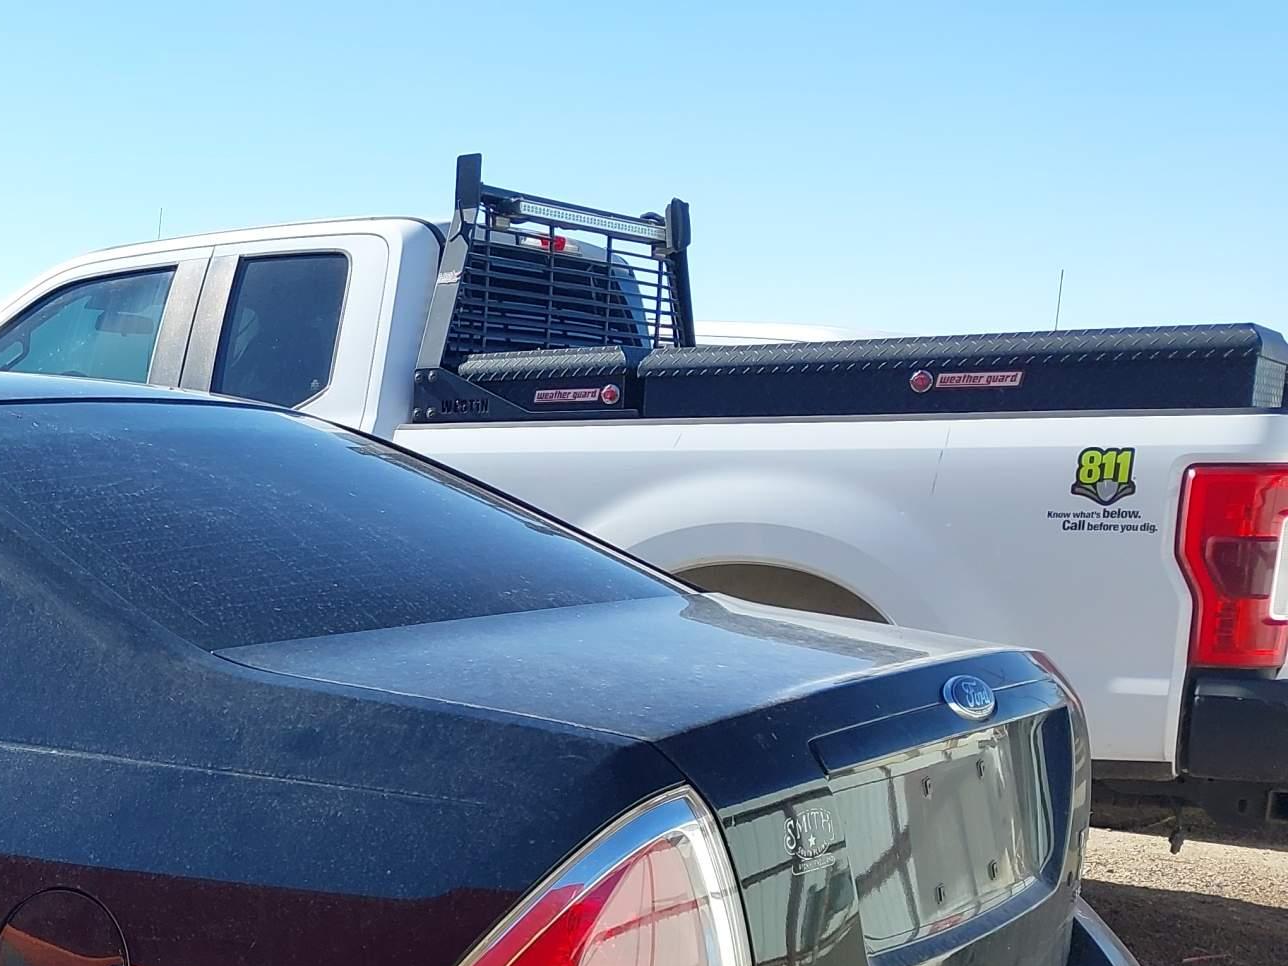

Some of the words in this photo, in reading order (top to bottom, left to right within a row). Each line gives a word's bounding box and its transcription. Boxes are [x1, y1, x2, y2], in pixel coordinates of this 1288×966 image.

[939, 373, 984, 384] weather
[986, 373, 1018, 385] guard
[1078, 448, 1133, 484] 811
[1047, 510, 1071, 519] Know
[1072, 510, 1101, 519] what's
[1102, 508, 1141, 519] below.
[1062, 520, 1085, 531] Call
[1087, 522, 1119, 531] before
[1120, 523, 1138, 533] you
[1140, 522, 1158, 534] dig.
[962, 681, 991, 708] Ford
[786, 811, 831, 849] SMITH
